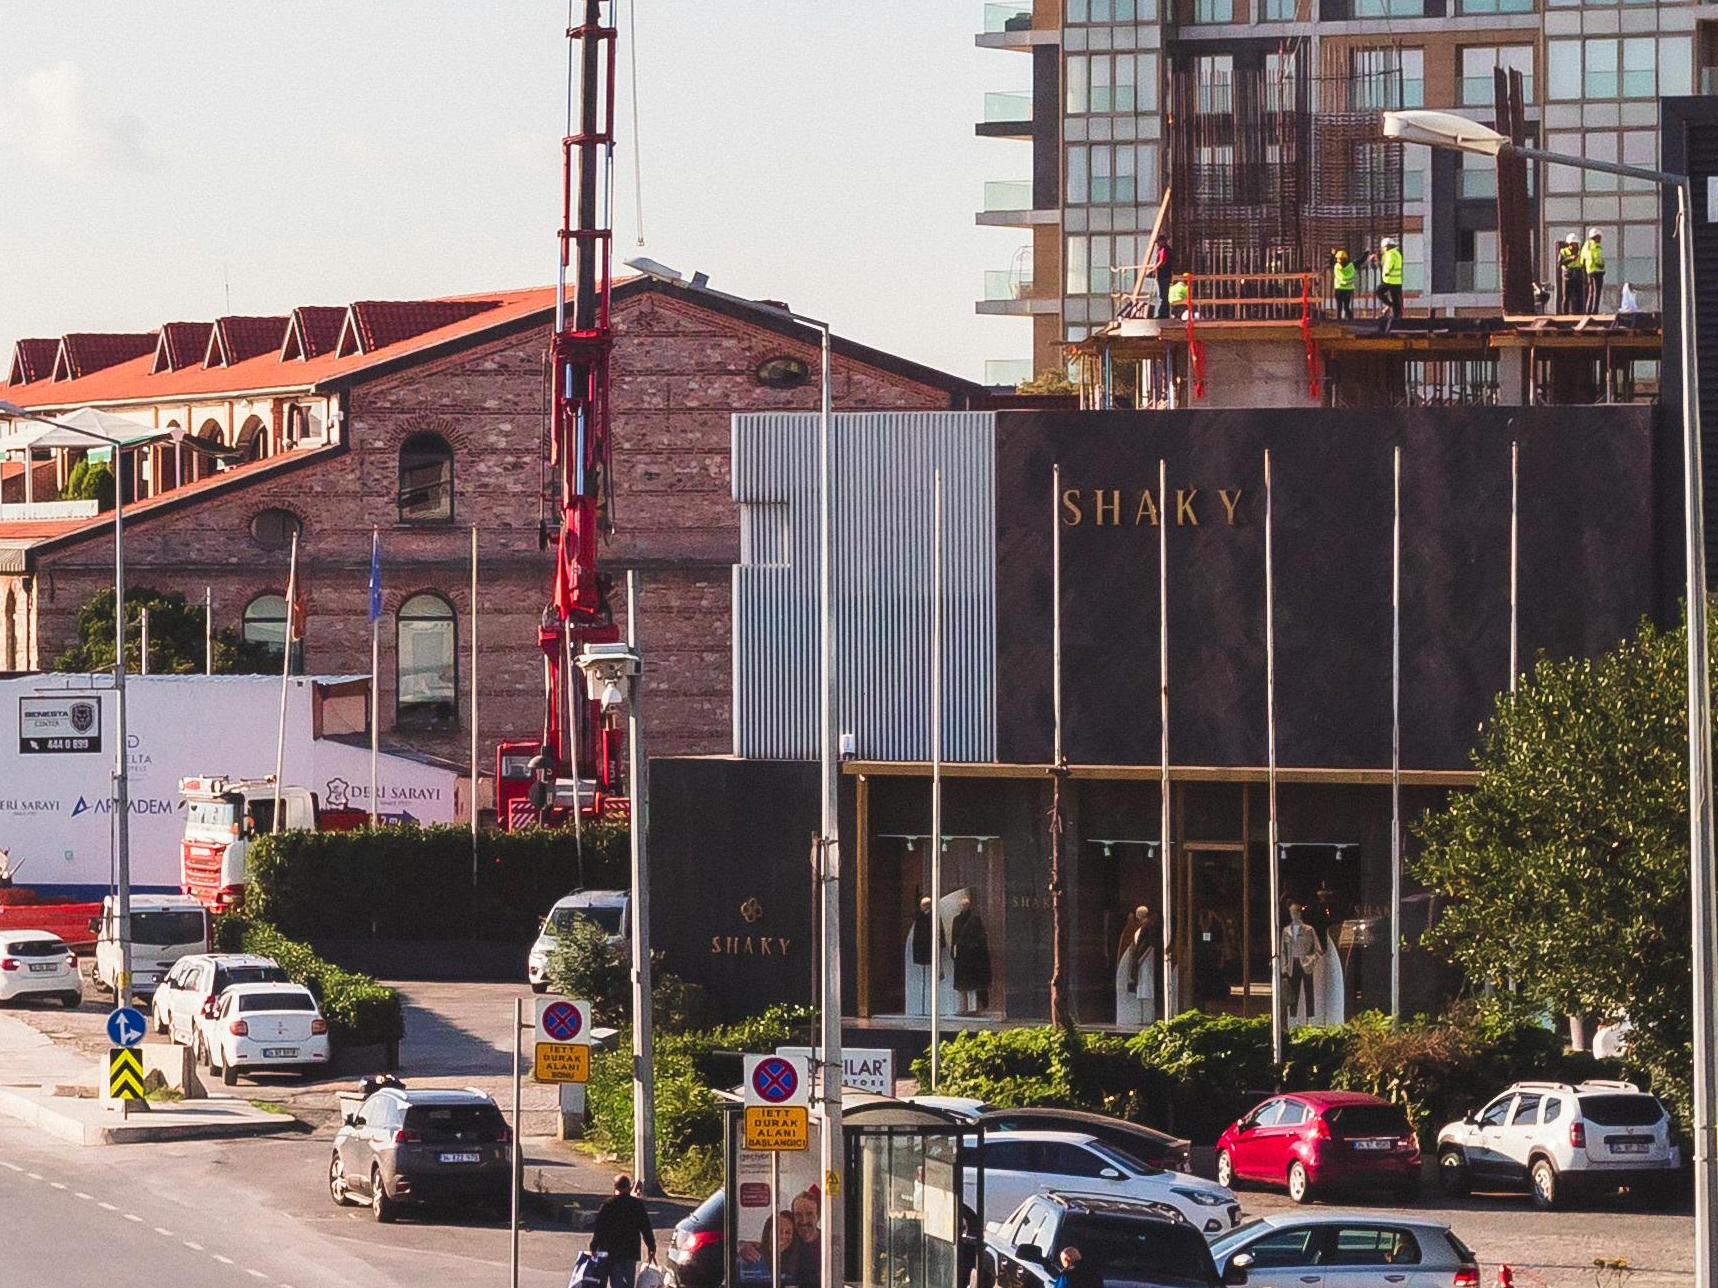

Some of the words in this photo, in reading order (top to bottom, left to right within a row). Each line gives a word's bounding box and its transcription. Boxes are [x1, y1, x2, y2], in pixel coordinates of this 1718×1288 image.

[1062, 488, 1243, 527] SHAKY
[391, 788, 440, 800] SARAYI
[22, 800, 60, 811] SARAYI
[712, 936, 790, 955] SHAKY
[543, 1054, 581, 1063] DURAK
[545, 1062, 580, 1071] ALANI
[754, 1119, 798, 1127] DURAK
[757, 1129, 796, 1137] ALANI
